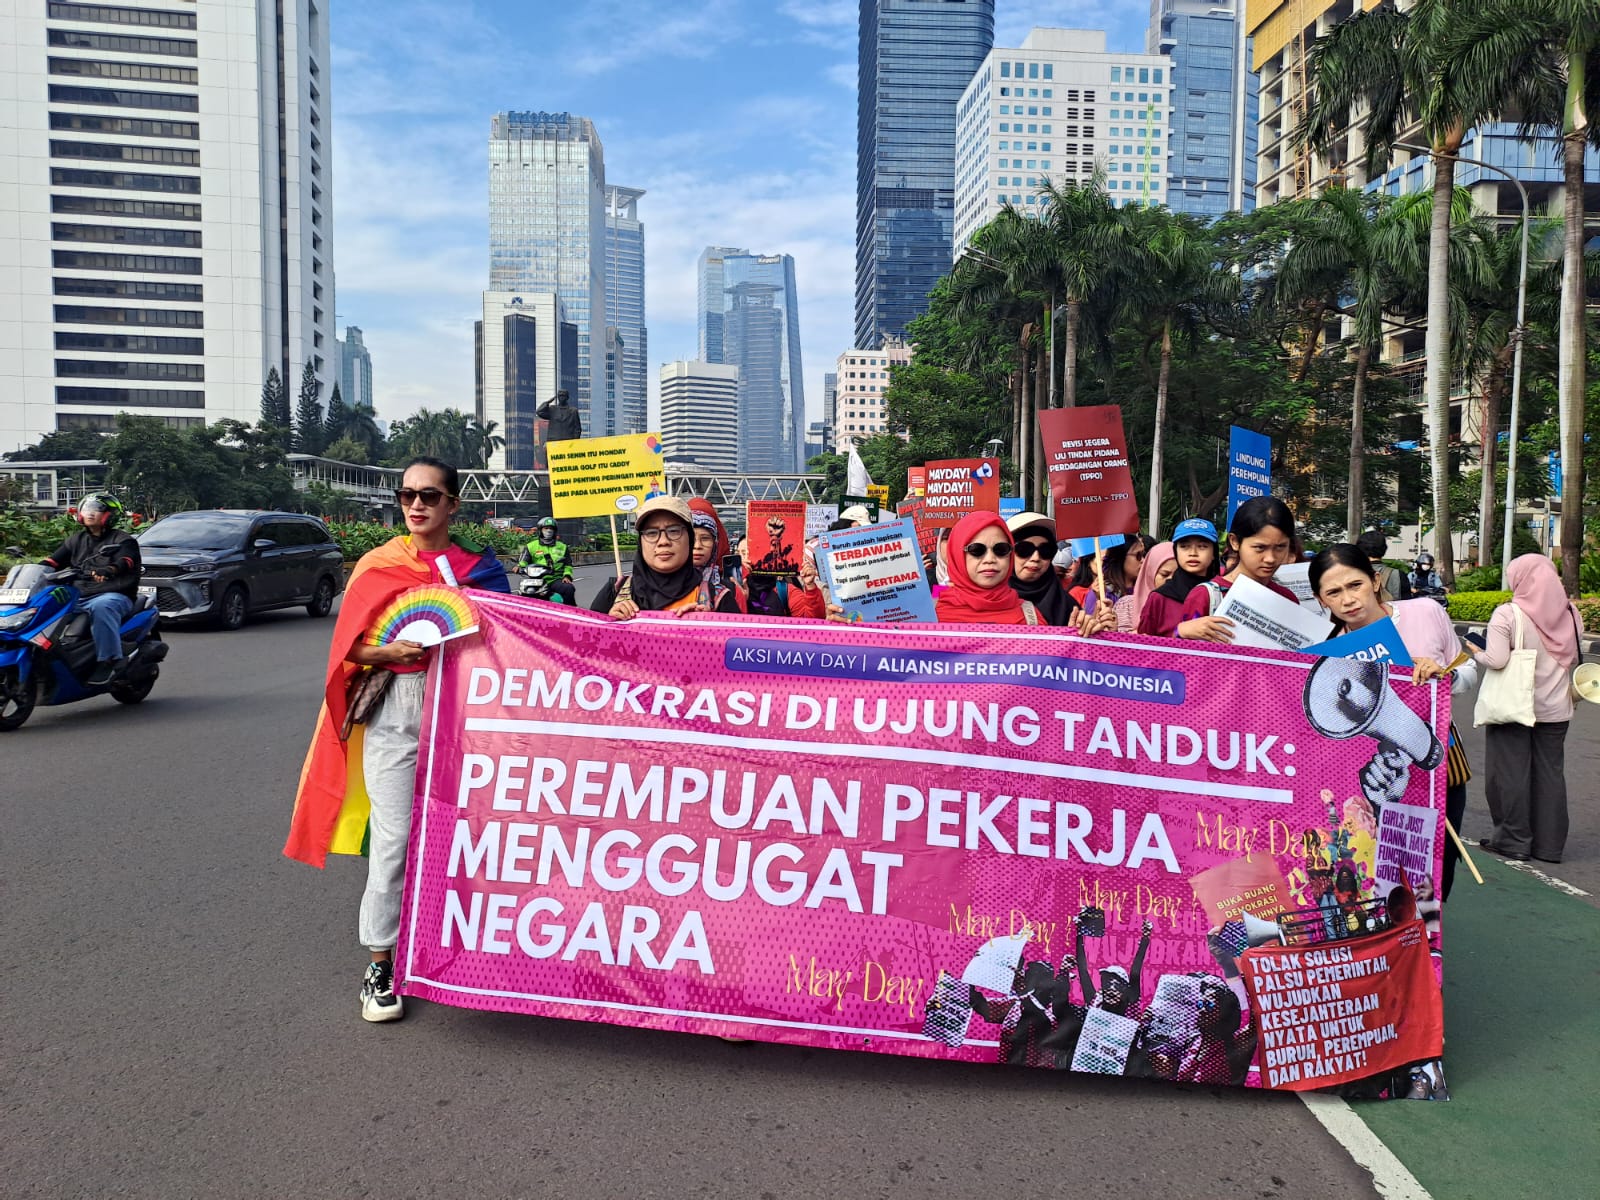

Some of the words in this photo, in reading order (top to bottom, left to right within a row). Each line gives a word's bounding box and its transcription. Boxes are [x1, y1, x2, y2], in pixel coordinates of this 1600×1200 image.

[1062, 439, 1083, 448] REVISI
[1084, 438, 1110, 447] SEGERA
[551, 453, 566, 461] HARI
[599, 448, 627, 456] MONDAY
[1054, 452, 1066, 460] UU
[1068, 451, 1093, 459] TINDAK
[1094, 448, 1120, 457] PIDANA
[1235, 452, 1266, 469] LINDUNGI
[552, 465, 579, 473] PEKERJA
[610, 460, 630, 468] CADDY
[929, 468, 971, 480] MAYDAY!
[1049, 461, 1102, 472] PERDAGANGAN
[1104, 459, 1128, 467] ORANG
[553, 478, 571, 486] LEBIH
[573, 476, 600, 484] PENTING
[636, 470, 662, 478] MAYDAY
[1080, 472, 1103, 481] (TPPO)
[1231, 467, 1270, 485] PEREMPUAN
[571, 489, 588, 497] PADA
[589, 487, 622, 495] ULTAHNYA
[927, 482, 972, 494] MAYDAY!!
[1237, 484, 1264, 496] PEKERJA
[926, 496, 975, 508] MAYDAY!!!
[1060, 496, 1080, 504] KERJA
[1082, 495, 1102, 503] PAKSA
[832, 541, 851, 550] Buruh
[852, 537, 876, 547] adalah
[876, 532, 903, 544] lapisan
[834, 541, 902, 561] TERBAWAH
[848, 559, 867, 568] rantai
[868, 556, 888, 566] pasok
[890, 551, 911, 561] global
[849, 573, 870, 583] paling
[866, 571, 920, 589] PERTAMA
[895, 583, 916, 593] buruk
[861, 597, 875, 605] dari
[1225, 610, 1242, 623] kasus
[1229, 603, 1238, 612] 10
[1237, 609, 1249, 619] ribu
[1250, 616, 1267, 629] orang
[732, 647, 771, 664] AKSI
[776, 650, 816, 668] MAY
[820, 652, 858, 671] DAY
[877, 656, 950, 676] ALIANSI
[954, 661, 1069, 683] PEREMPUAN
[1072, 667, 1174, 695] INDONESIA
[466, 667, 772, 728] DEMOKRASI
[784, 696, 838, 731] DI
[853, 696, 1042, 747] UJUNG
[1055, 710, 1297, 778] TANDUK:
[458, 753, 862, 839] PEREMPUAN
[881, 783, 1182, 875] PEKERJA
[1382, 809, 1405, 829] GIRLS
[1405, 815, 1425, 835] JUST
[1196, 811, 1259, 864] May
[1380, 827, 1407, 848] WANNA
[1409, 835, 1431, 855] HAVE
[446, 819, 904, 916] MENGGUGAT
[1079, 877, 1128, 922] May
[1136, 884, 1182, 928] Day
[1216, 895, 1244, 910] BUKA
[1244, 883, 1277, 900] RUANG
[1225, 895, 1278, 919] DEMOKRASI
[440, 889, 716, 975] NEGARA
[950, 903, 1000, 948] May
[1009, 908, 1057, 953] Day
[1250, 953, 1301, 974] TOLAK
[1304, 946, 1354, 967] SOLUSI
[1253, 971, 1304, 993] PALSU
[1306, 955, 1390, 986] PEMERINTAH,
[787, 953, 852, 1012] May
[863, 960, 924, 1019] Day
[1256, 983, 1342, 1012] WUJUDKAN
[1260, 993, 1380, 1031] KESEJAHTERAAN
[1264, 1028, 1318, 1049] NYATA
[1320, 1015, 1365, 1038] UNTUK
[1266, 1043, 1320, 1069] BURUH,
[1324, 1023, 1398, 1056] PEREMPUAN,
[1268, 1066, 1301, 1088] DAN
[1304, 1050, 1368, 1080] RAKYAT!
